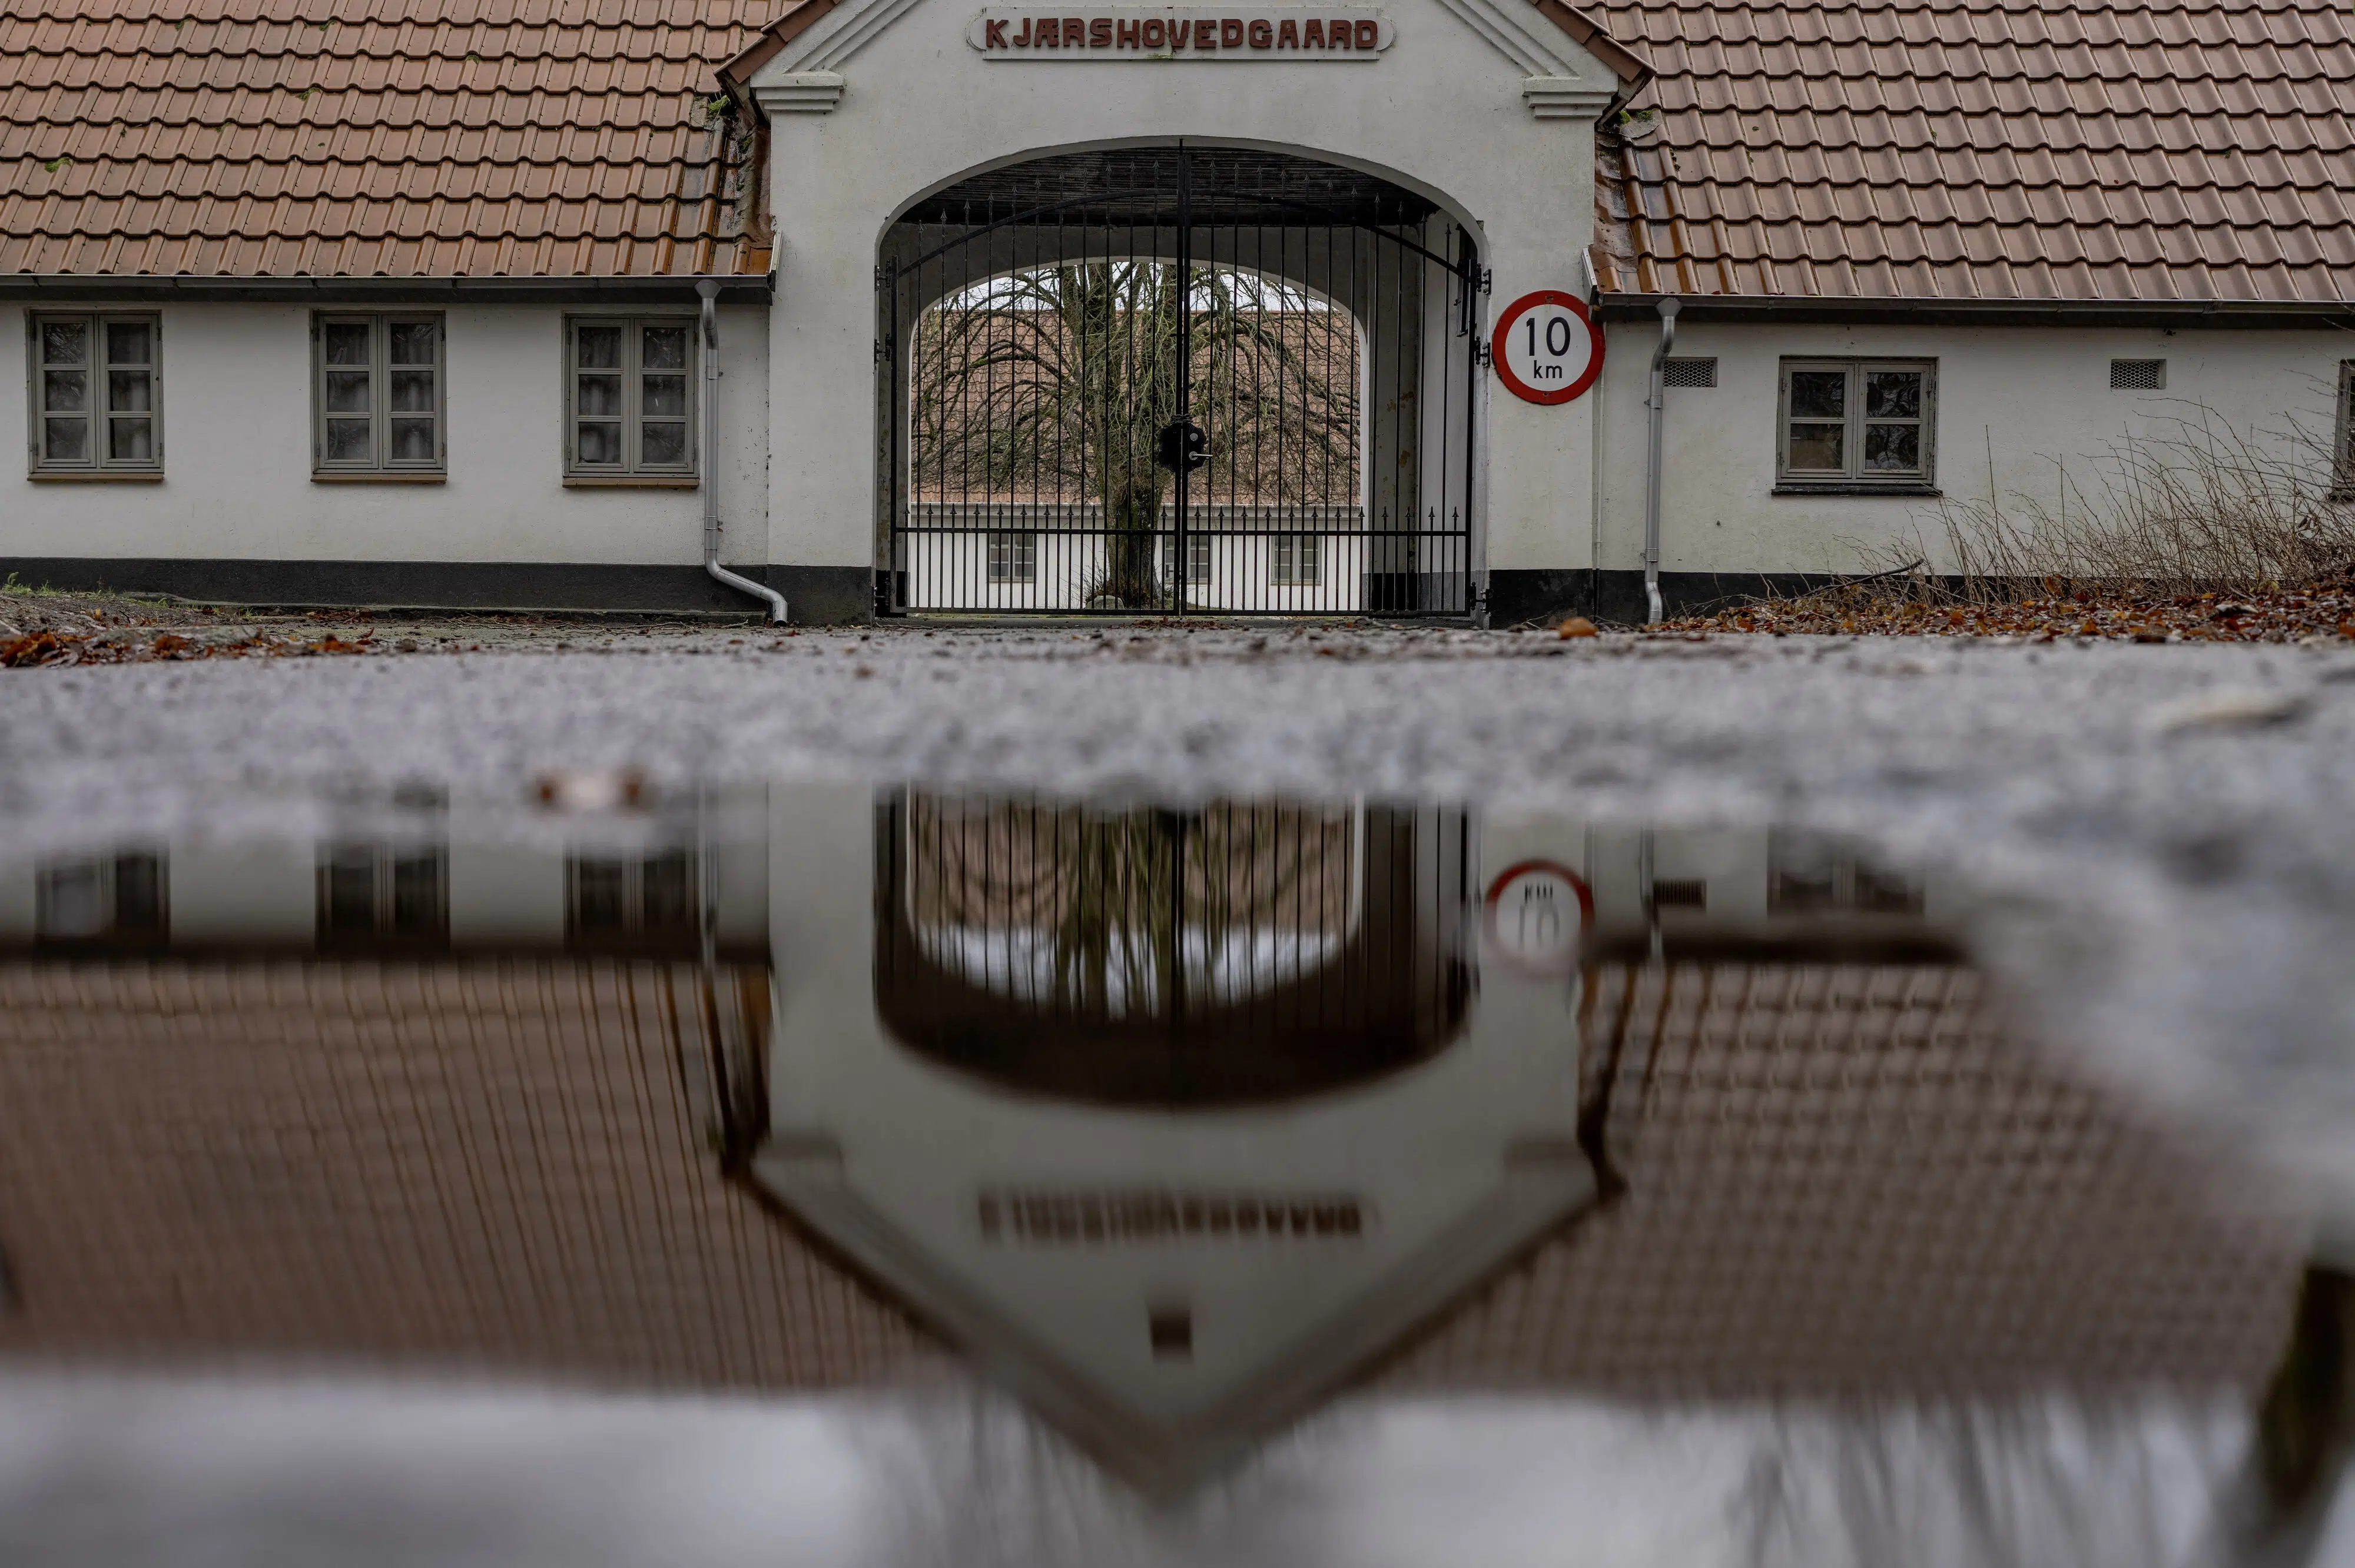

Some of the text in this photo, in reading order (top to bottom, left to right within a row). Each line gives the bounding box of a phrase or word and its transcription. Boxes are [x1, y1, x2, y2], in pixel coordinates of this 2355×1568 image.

[986, 17, 1378, 48] KJÆRSHOVEDGAARD
[1526, 316, 1571, 357] 10
[1533, 360, 1563, 379] km
